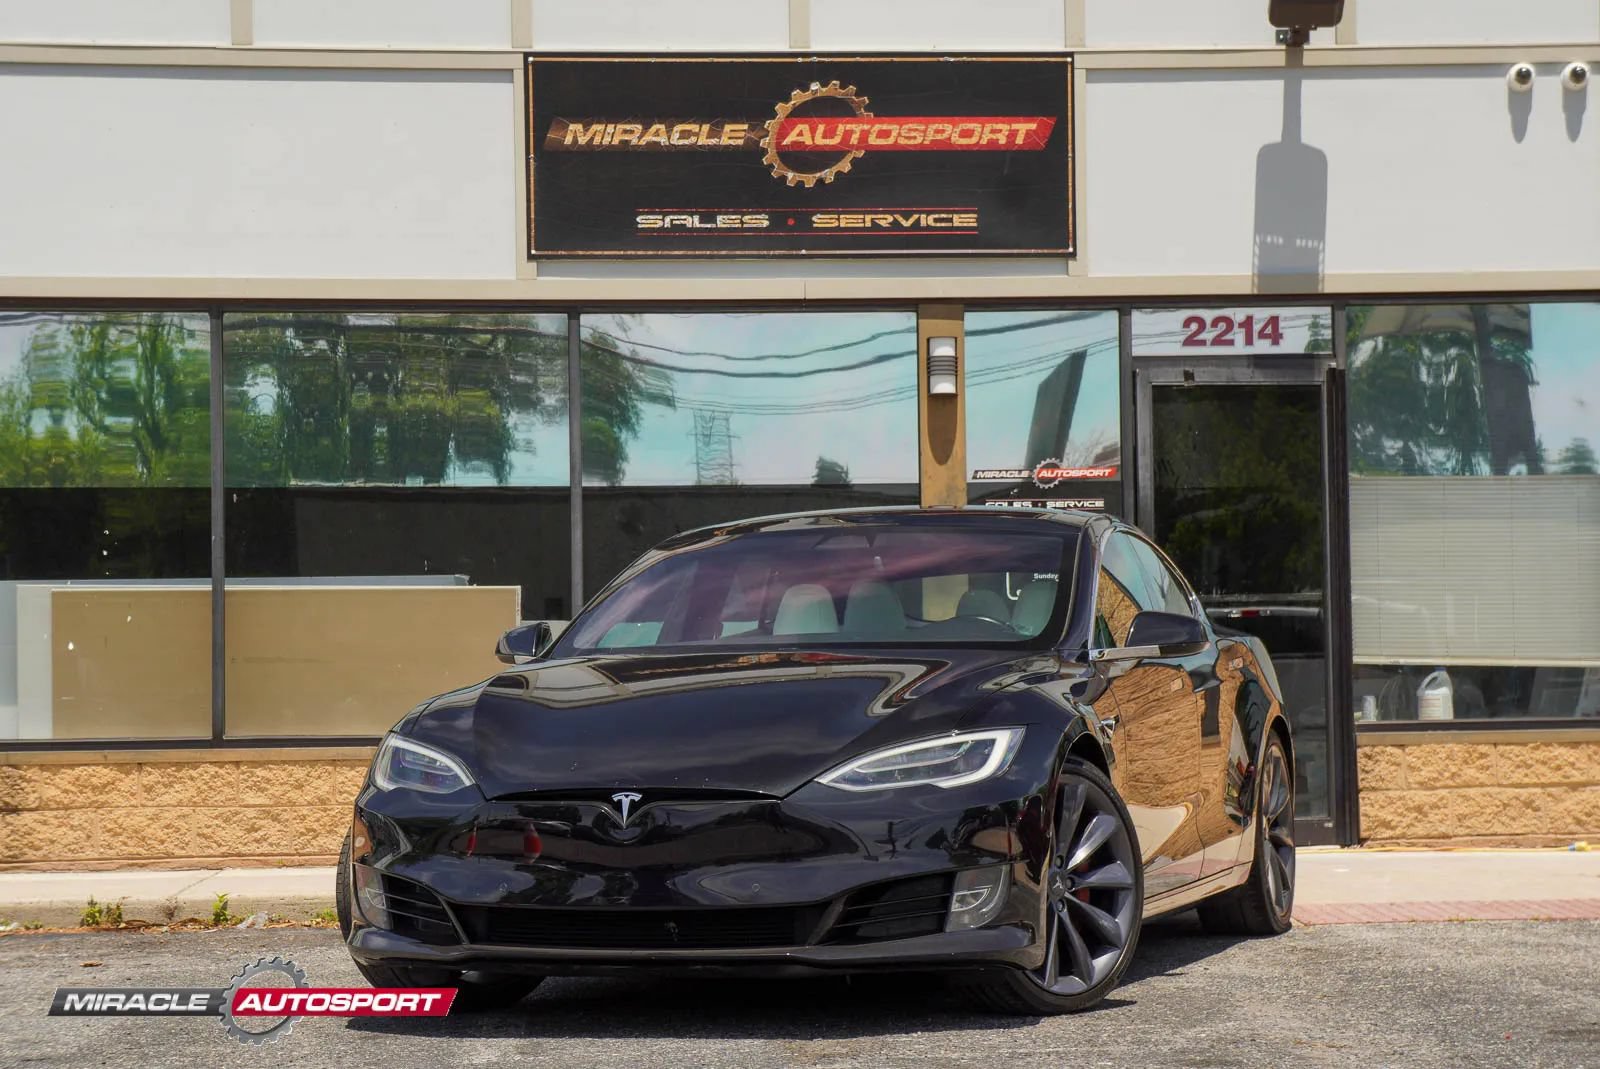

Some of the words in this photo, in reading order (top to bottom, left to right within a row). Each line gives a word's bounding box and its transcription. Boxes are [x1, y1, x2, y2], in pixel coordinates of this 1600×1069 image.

[563, 122, 749, 146] MIRACLE
[782, 121, 1038, 147] AUTOSPORT
[636, 214, 770, 229] SALES
[811, 213, 979, 228] SERVICE
[1181, 316, 1284, 347] 2214
[976, 470, 1030, 478] MIRACLE
[1038, 468, 1112, 477] AUTOSPORT
